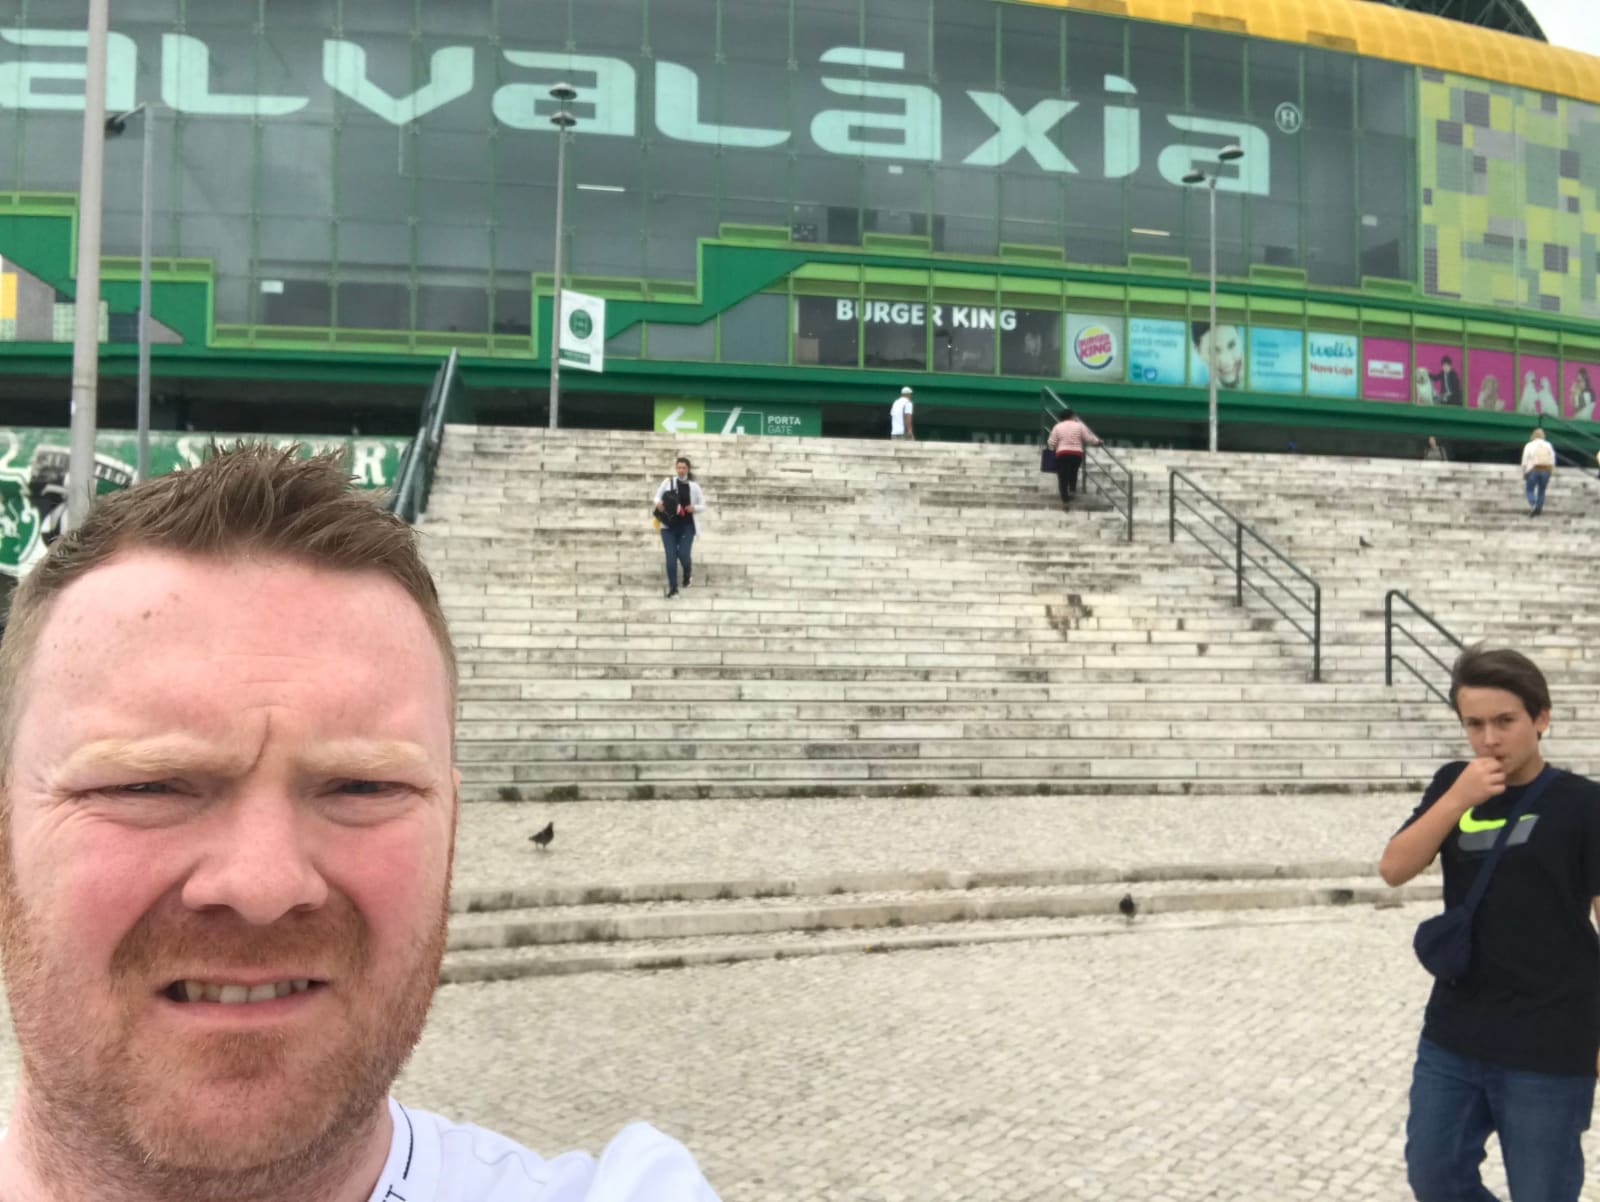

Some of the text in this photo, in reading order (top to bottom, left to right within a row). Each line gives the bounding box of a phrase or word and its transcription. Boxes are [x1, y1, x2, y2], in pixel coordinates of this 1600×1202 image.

[836, 299, 1017, 331] BURGER KING
[1078, 333, 1111, 347] BURGER
[1079, 342, 1112, 359] KING
[768, 415, 801, 425] PORTA
[768, 426, 793, 435] GATE
